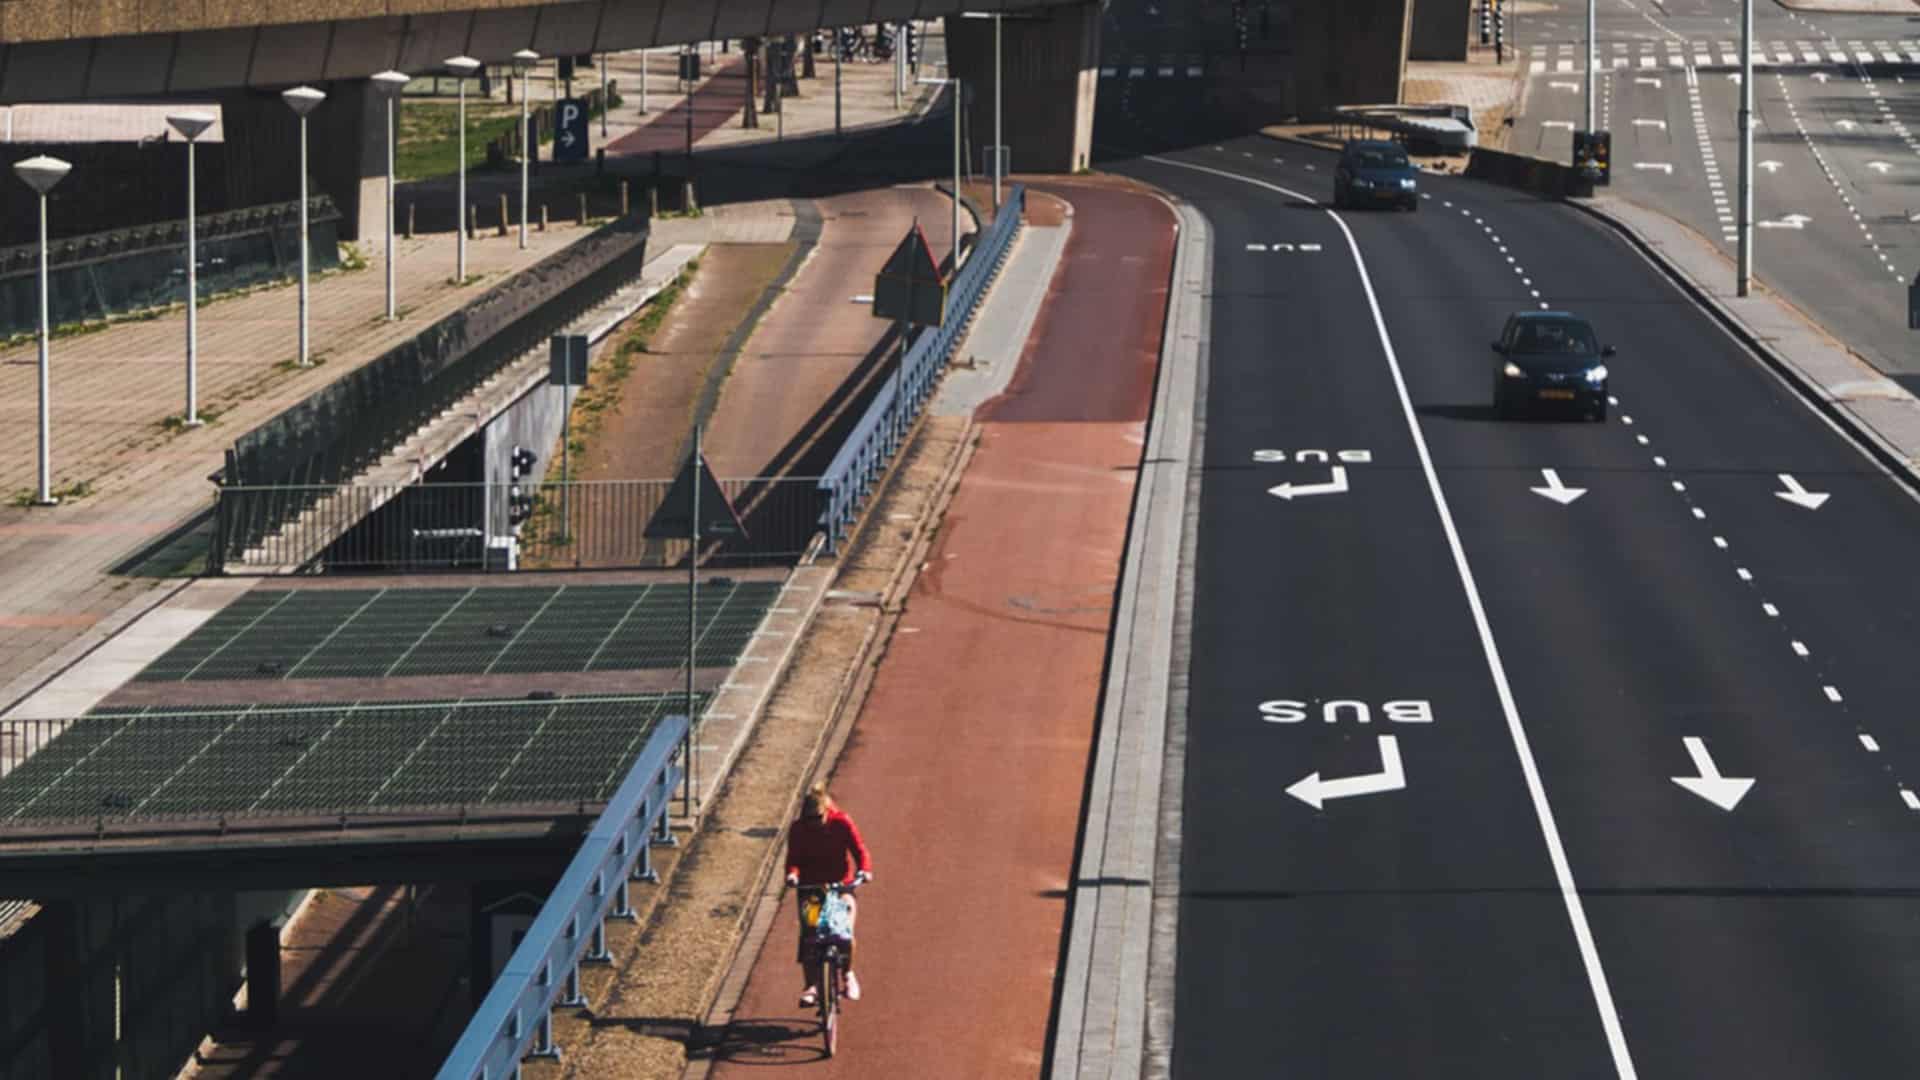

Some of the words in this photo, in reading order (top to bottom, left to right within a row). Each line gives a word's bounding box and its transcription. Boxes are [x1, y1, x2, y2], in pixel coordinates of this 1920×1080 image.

[563, 104, 579, 129] P
[1252, 449, 1372, 463] BUS
[1258, 699, 1433, 724] BUS
